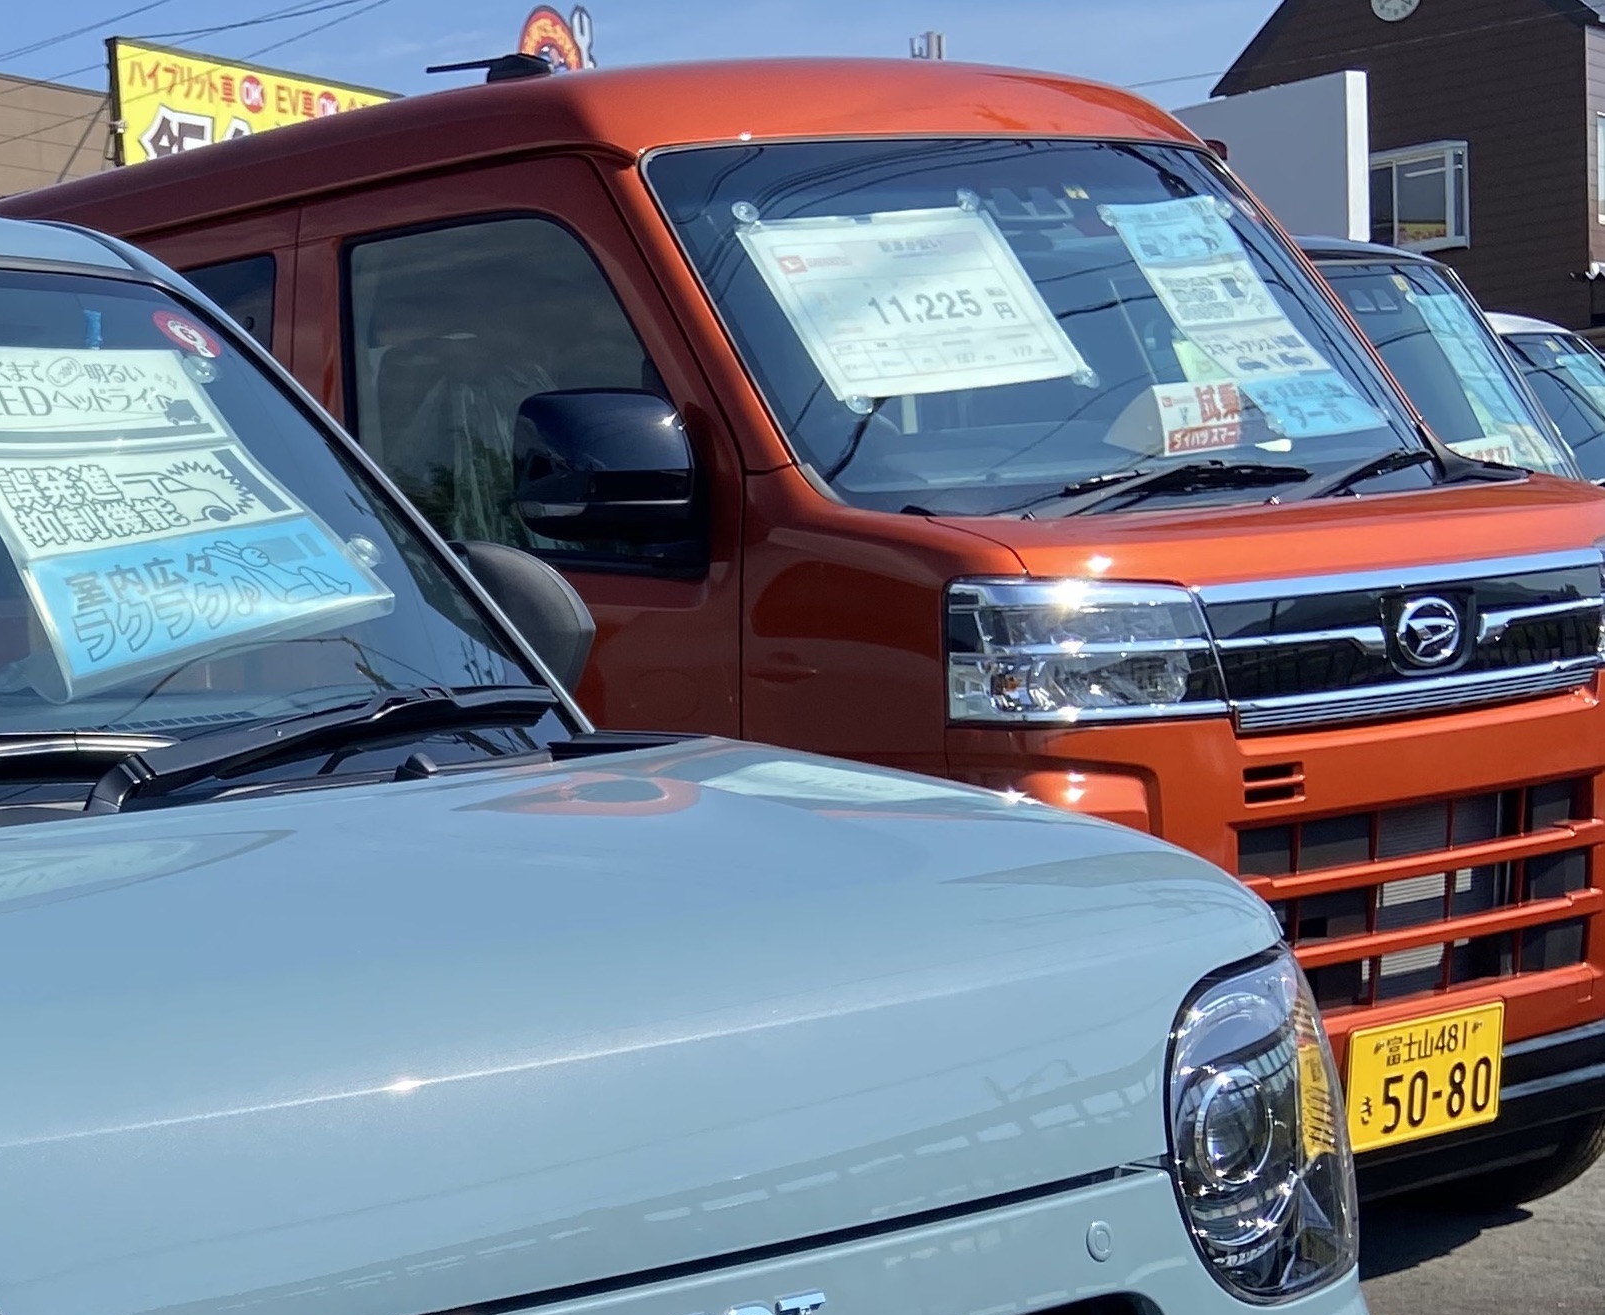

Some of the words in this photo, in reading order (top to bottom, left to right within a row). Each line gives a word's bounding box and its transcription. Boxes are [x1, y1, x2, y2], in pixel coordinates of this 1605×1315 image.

[868, 288, 982, 325] 11,225
[995, 301, 1019, 319] 円
[83, 362, 147, 384] 明るい
[14, 496, 191, 548] 抑制機能
[63, 552, 218, 611] 室内広々
[1386, 1020, 1468, 1067] 富士山481
[1380, 1056, 1492, 1134] 50-80
